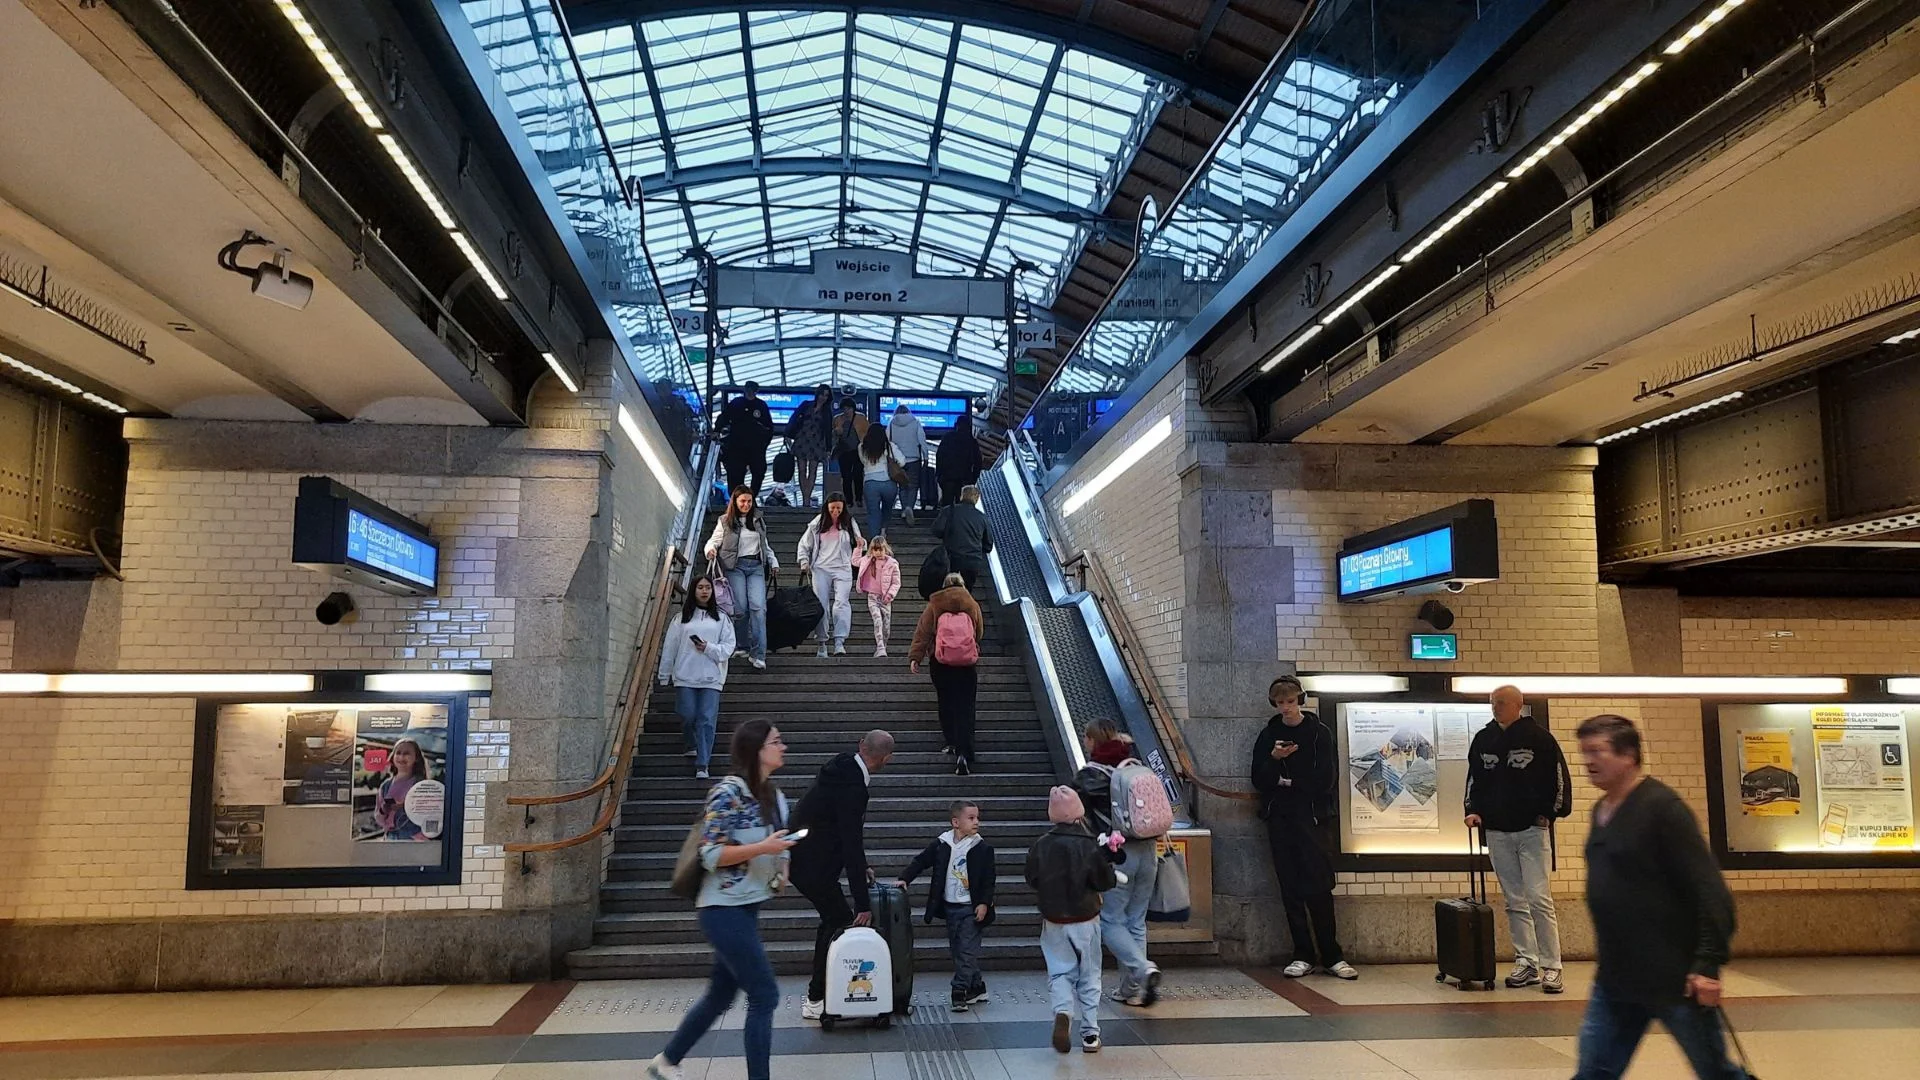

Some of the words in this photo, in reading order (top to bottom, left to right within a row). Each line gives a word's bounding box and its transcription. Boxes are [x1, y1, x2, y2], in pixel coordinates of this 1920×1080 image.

[835, 259, 891, 273] Wejście
[817, 289, 838, 300] na
[844, 290, 892, 303] peron
[897, 290, 908, 302] 2
[673, 316, 688, 329] or
[691, 315, 701, 330] 3
[1017, 329, 1039, 343] tor
[1041, 328, 1052, 343] 4
